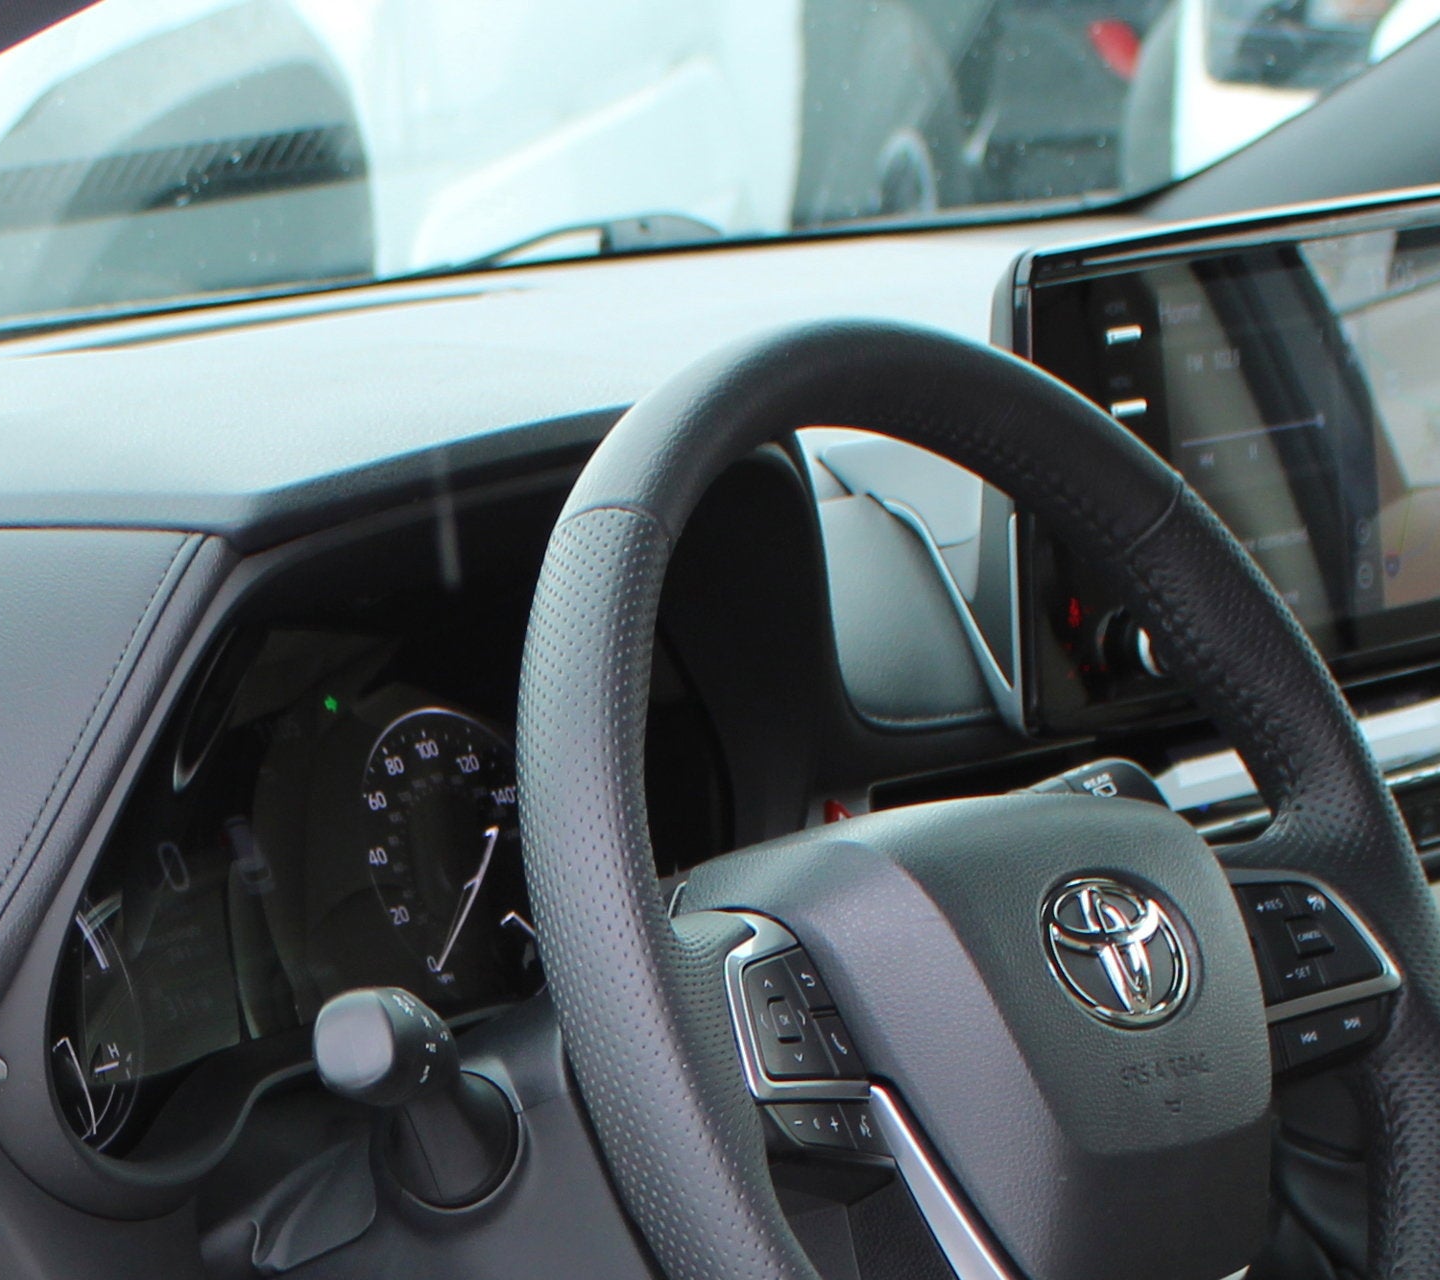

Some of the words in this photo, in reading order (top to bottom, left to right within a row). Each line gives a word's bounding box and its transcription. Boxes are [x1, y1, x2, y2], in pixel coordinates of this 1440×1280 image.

[415, 739, 439, 760] 100
[384, 755, 405, 777] 80
[456, 753, 480, 775] 120
[368, 790, 387, 811] 60
[491, 787, 515, 806] 140
[369, 847, 388, 866] 40
[390, 905, 410, 926] 20
